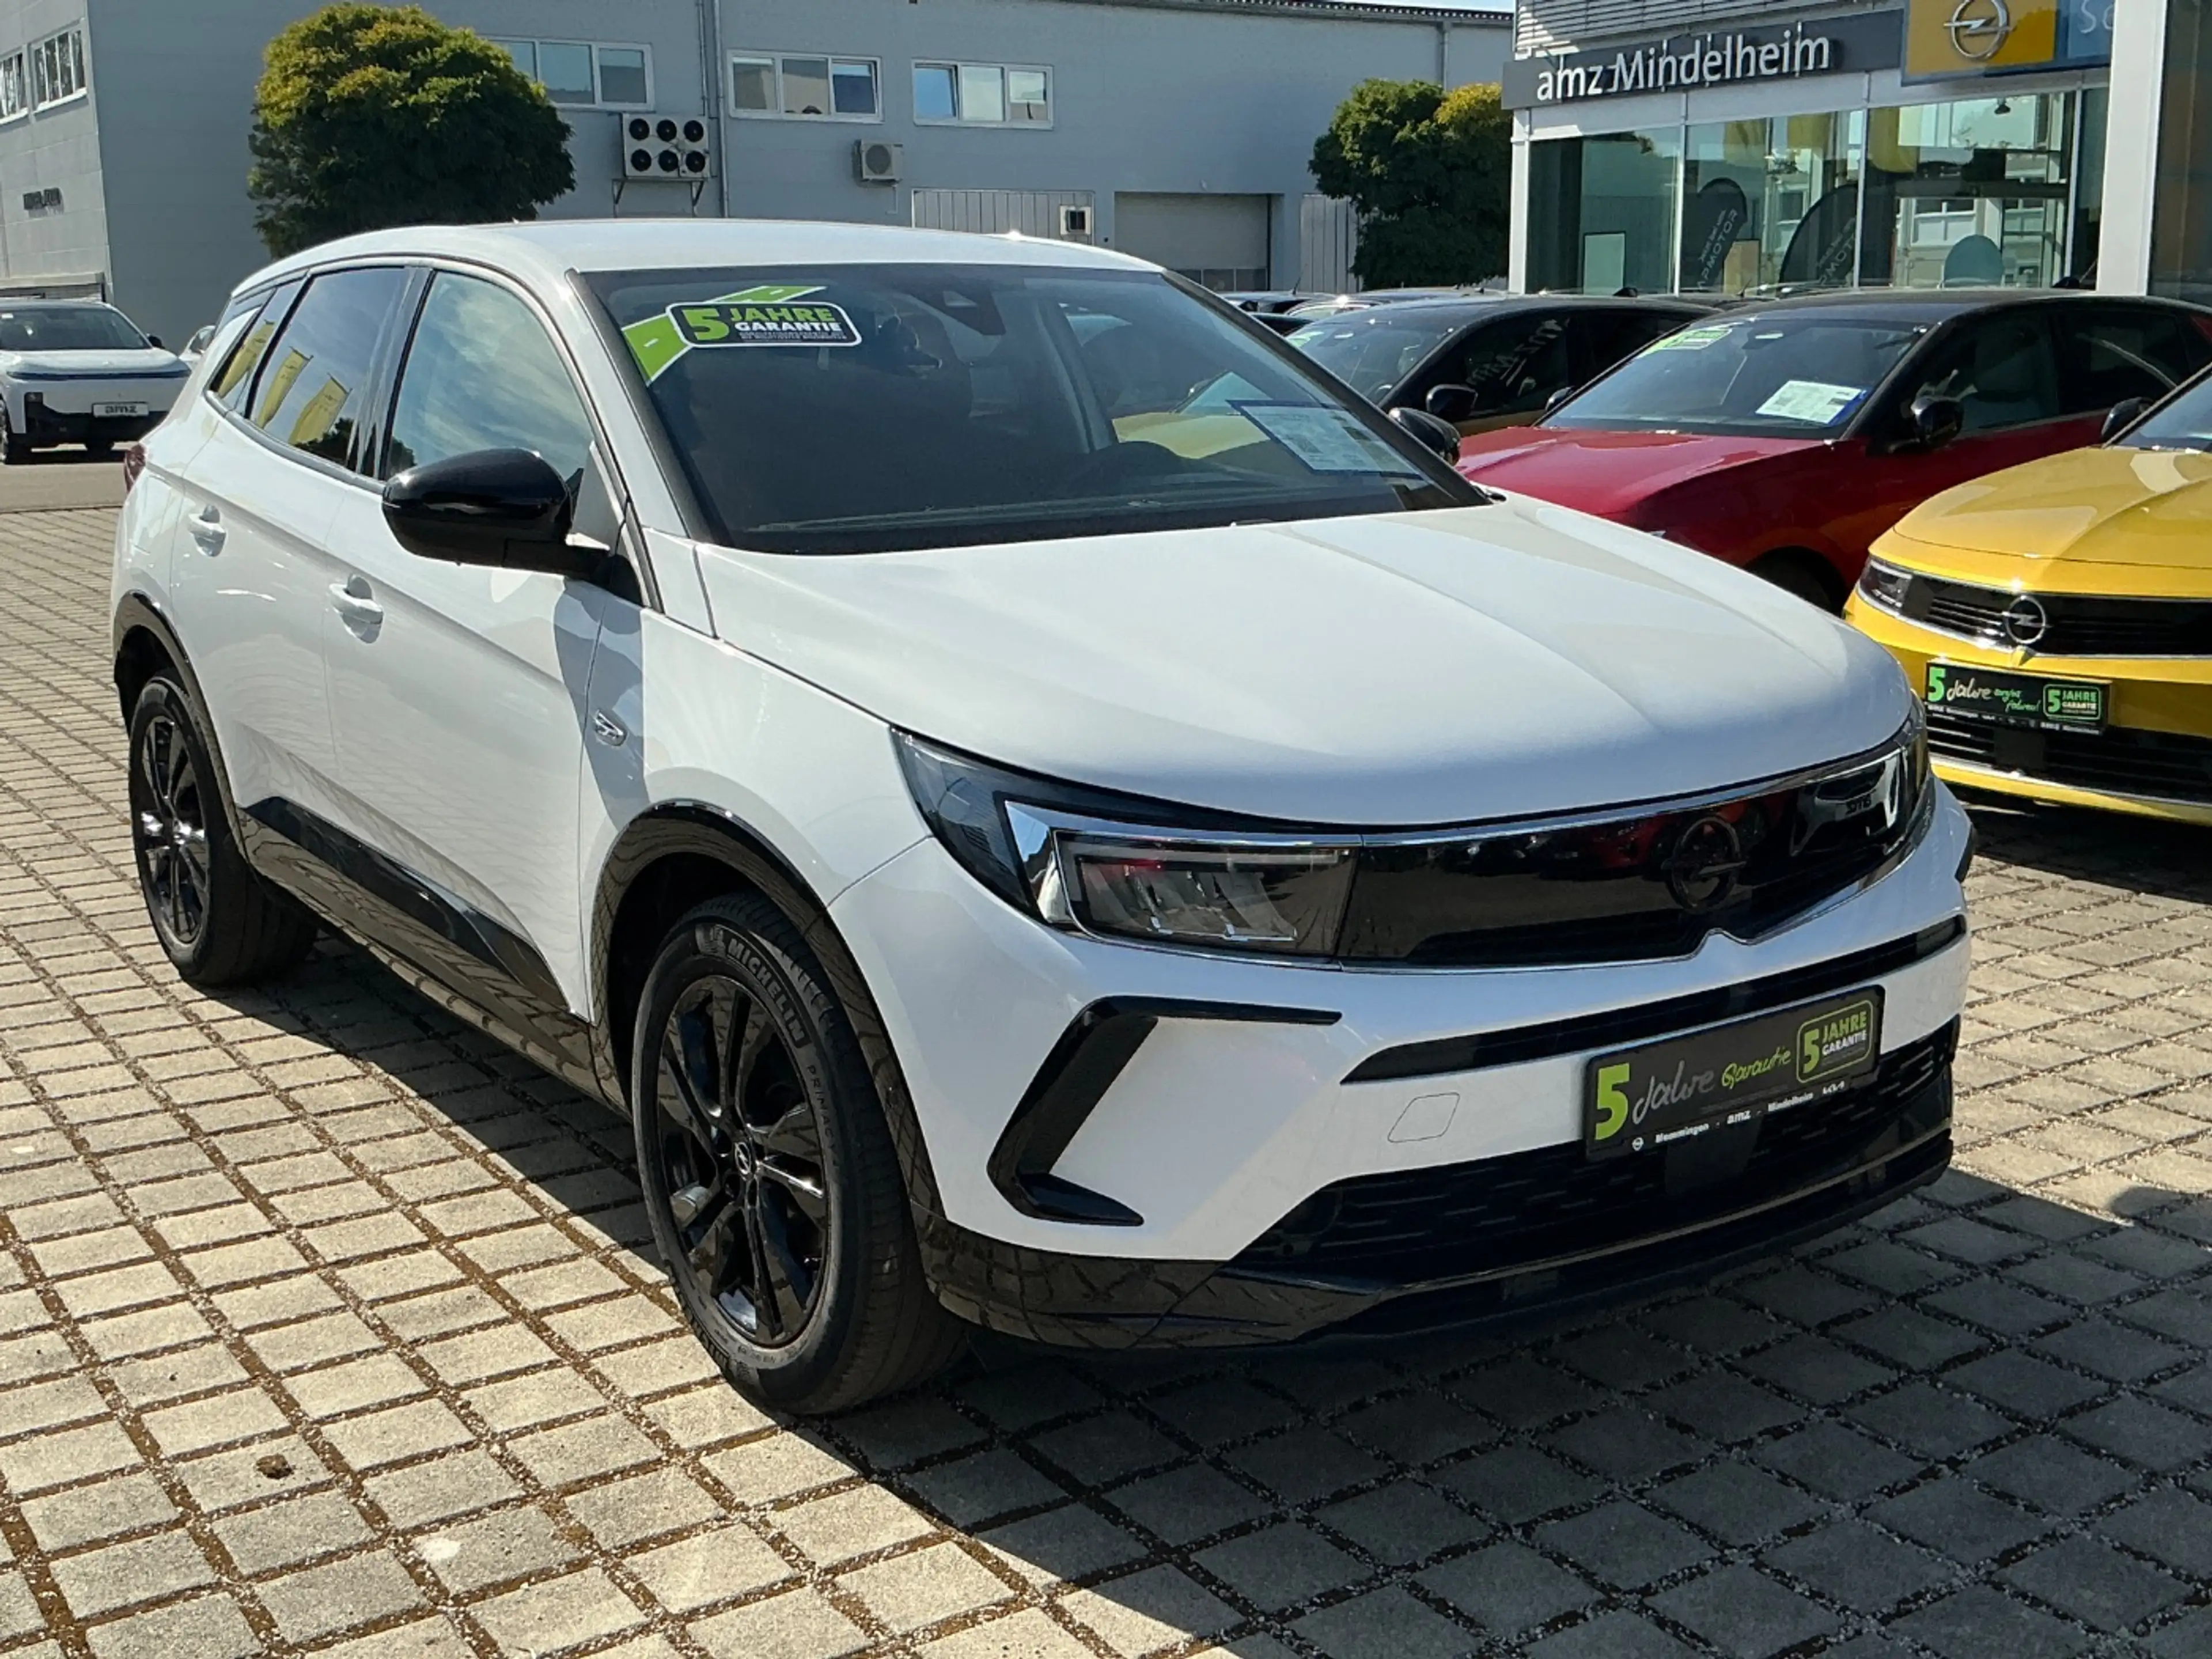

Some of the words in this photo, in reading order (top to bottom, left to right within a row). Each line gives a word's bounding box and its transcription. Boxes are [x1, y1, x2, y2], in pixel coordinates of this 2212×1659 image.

[1536, 64, 1603, 101] amz
[1609, 30, 1830, 92] Mindelheim
[682, 308, 729, 340] 5
[730, 308, 835, 322] JAHRE
[734, 321, 842, 332] GARANTIE
[1927, 666, 1946, 702] 5
[2048, 690, 2061, 713] 5
[2062, 690, 2097, 702] JAHRE
[727, 938, 806, 1042] MICHELIN
[1804, 1029, 1820, 1074] 5
[1823, 1011, 1867, 1043] JAHRE
[1821, 1029, 1867, 1055] GARANTIE
[1595, 1062, 1630, 1141] 5
[1721, 1045, 1791, 1089] Garantie
[1726, 1109, 1752, 1124] amz
